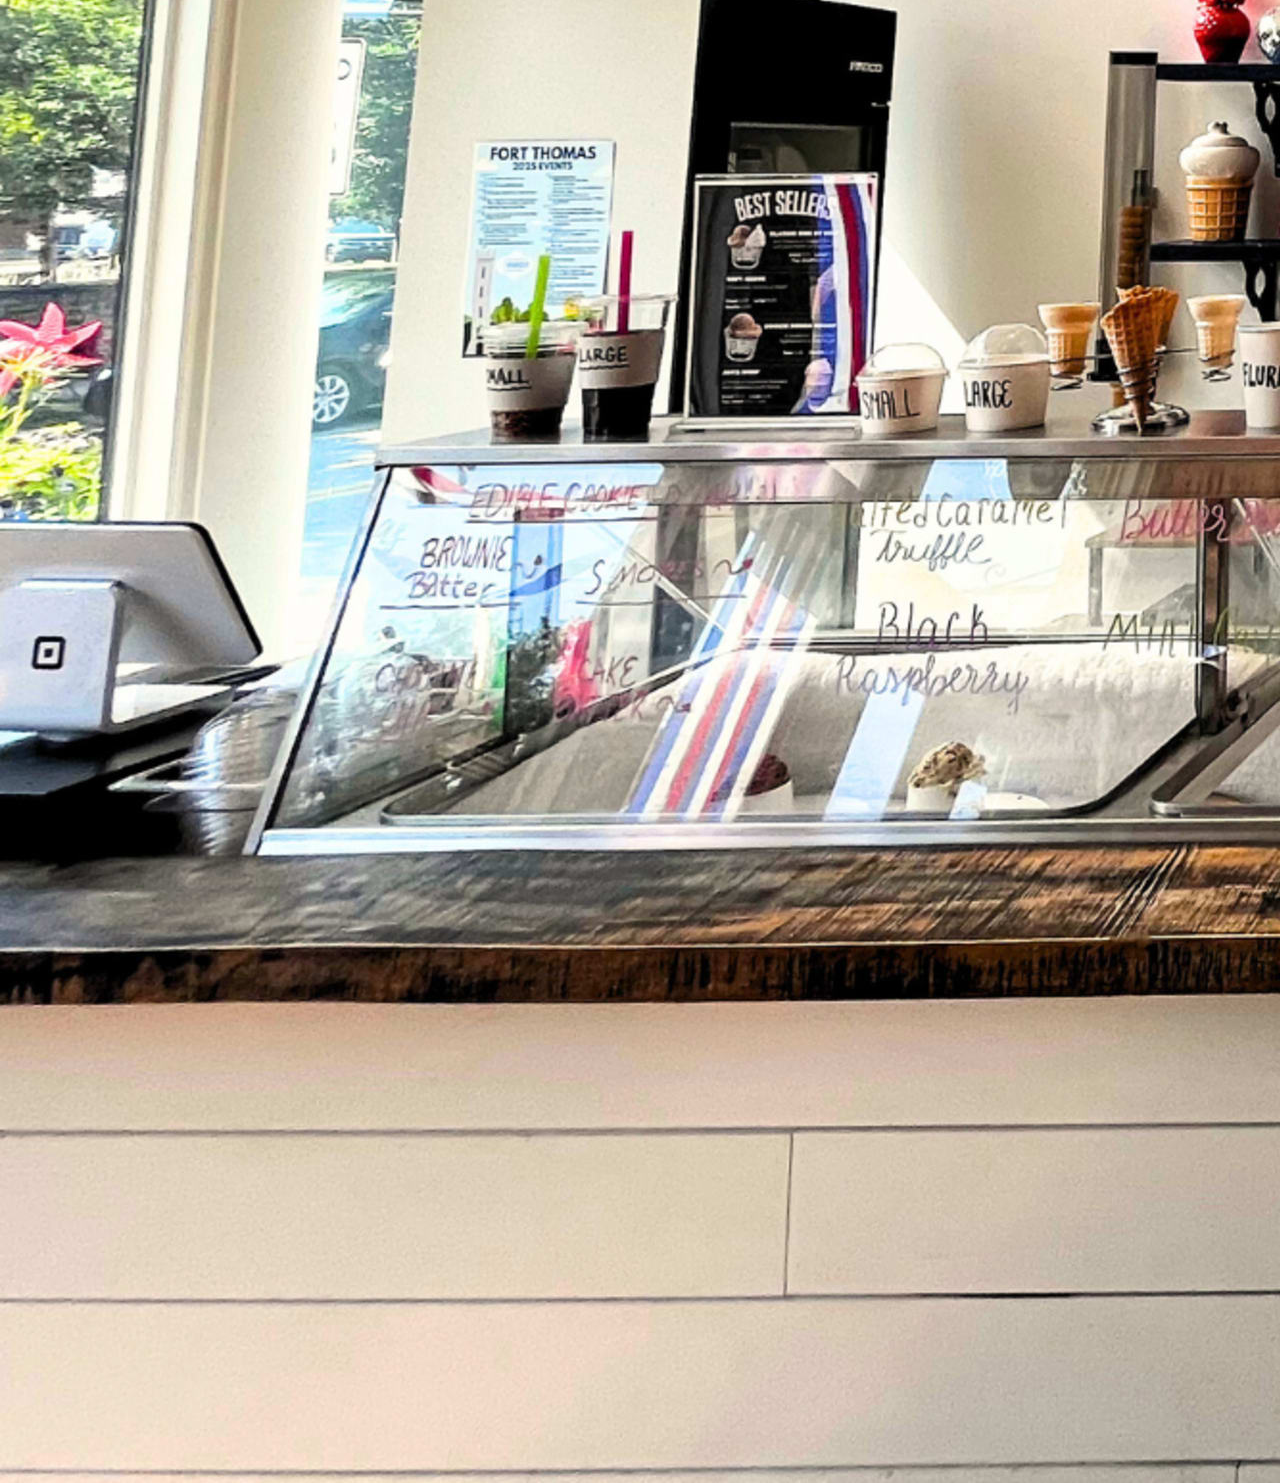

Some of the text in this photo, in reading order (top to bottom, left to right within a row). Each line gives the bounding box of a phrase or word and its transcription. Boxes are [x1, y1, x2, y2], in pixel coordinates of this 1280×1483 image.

[491, 147, 596, 160] FORT THOMAS
[539, 162, 573, 170] EVENTS
[735, 192, 772, 221] BEST
[580, 346, 627, 362] LARGE
[863, 389, 920, 418] SMALL
[963, 381, 1012, 408] LARGE
[937, 494, 1068, 529] Caramel
[421, 537, 514, 570] BROWNIE
[870, 529, 992, 570] Truffle
[877, 603, 989, 648] Black
[835, 655, 1030, 712] Raspberry
